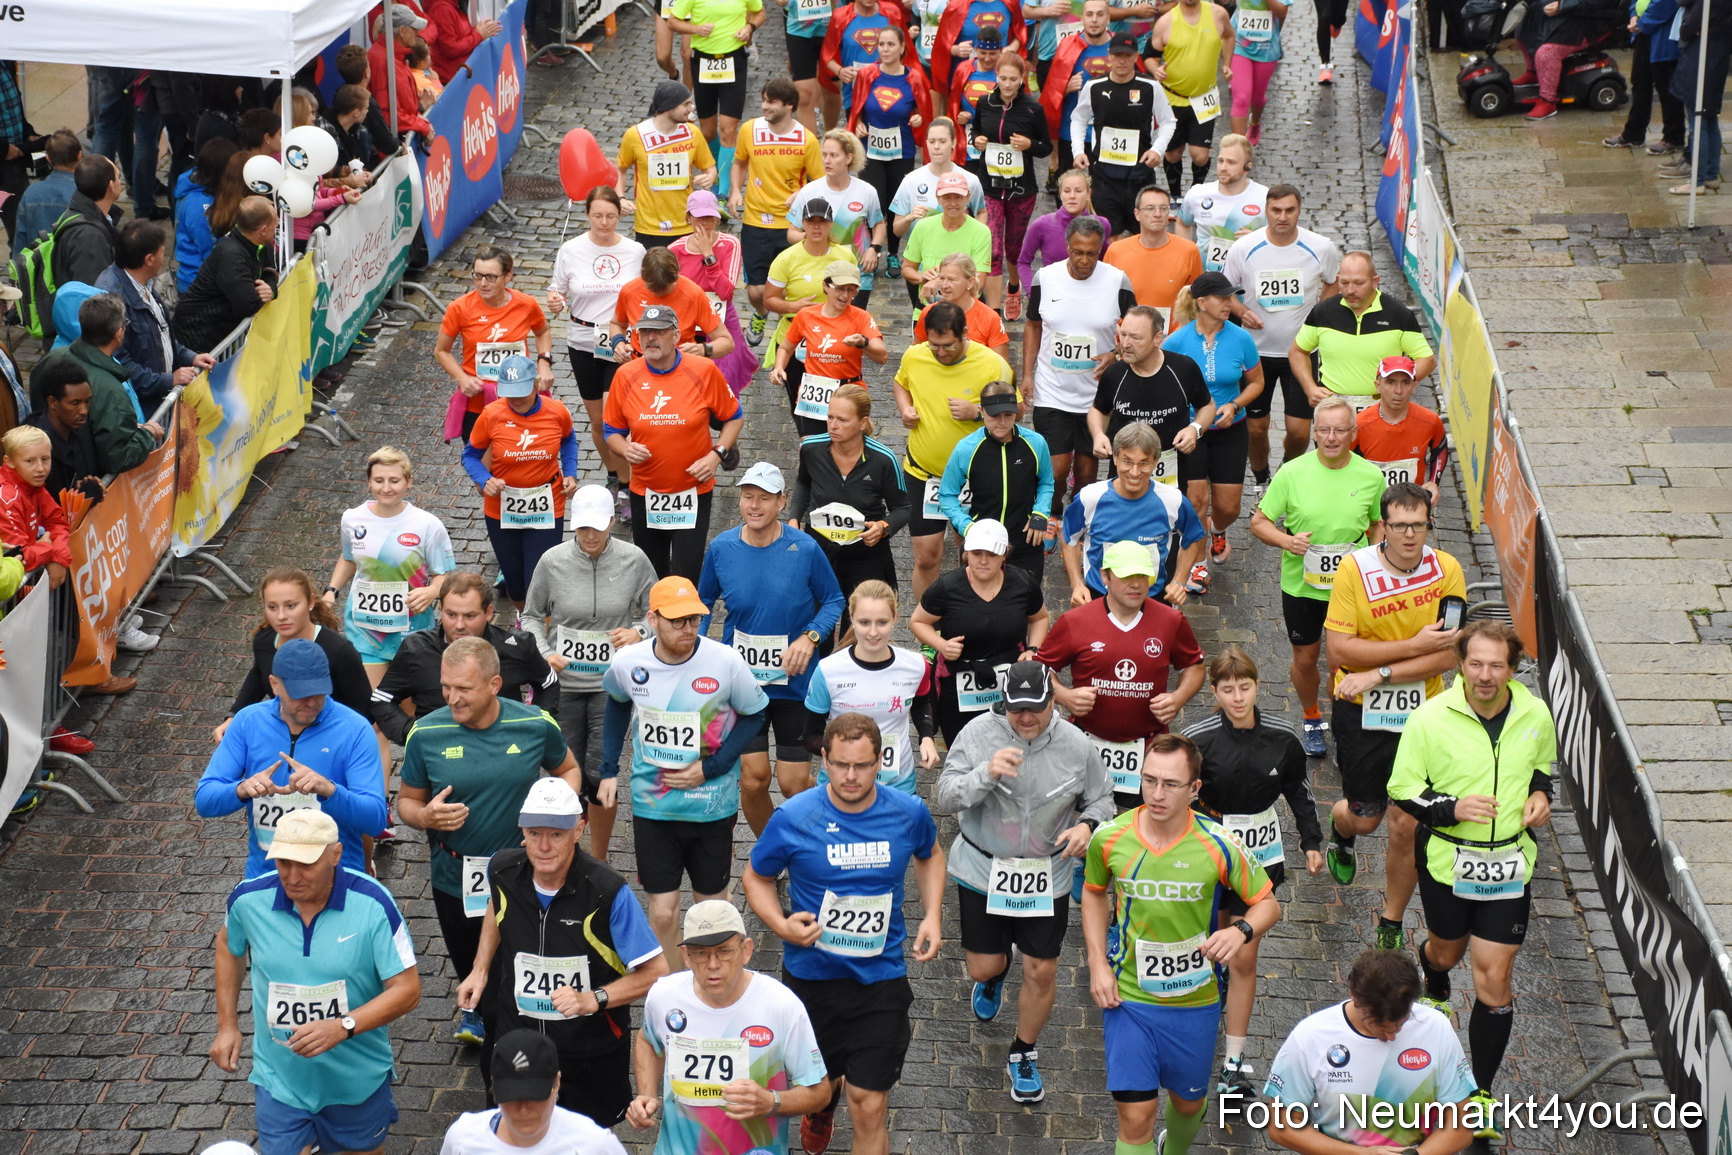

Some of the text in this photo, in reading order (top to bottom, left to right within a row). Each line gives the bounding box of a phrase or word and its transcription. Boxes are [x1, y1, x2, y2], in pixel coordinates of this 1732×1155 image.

[1242, 18, 1269, 30] 2470
[707, 59, 727, 70] 228
[498, 62, 520, 116] Hervis
[1203, 94, 1216, 107] 40
[463, 101, 497, 164] Hervis
[672, 142, 696, 154] BÖGL
[870, 135, 898, 149] 2061
[1111, 137, 1127, 151] 34
[753, 147, 805, 156] MAX BÖGL
[997, 151, 1013, 166] 68
[657, 162, 681, 176] 311
[425, 153, 451, 222] Hervis
[1261, 279, 1300, 296] 2913
[1271, 298, 1290, 306] Armin
[810, 350, 842, 360] funrunners
[1054, 341, 1091, 360] 3071
[801, 384, 834, 404] 2330
[638, 412, 680, 422] funrunners
[1122, 406, 1178, 419] Laufen gegen
[650, 417, 686, 427] neumarkt
[503, 449, 547, 459] funrunners
[515, 453, 553, 462] neumarkt
[506, 495, 550, 514] 2243
[650, 493, 694, 512] 2244
[510, 514, 546, 523] Hannelore
[655, 514, 687, 524] Siegfried
[822, 513, 855, 528] 109
[830, 531, 846, 541] Elke
[358, 591, 404, 613] 2266
[1371, 599, 1409, 619] MAX
[365, 615, 394, 626] Simone
[562, 638, 610, 662] 2838
[737, 644, 783, 668] 3045
[569, 661, 600, 673] Kristina
[695, 681, 717, 690] Hervis
[1091, 677, 1154, 691] NÜRNBERGER
[975, 693, 1000, 704] Nicole
[1369, 689, 1421, 711] 2769
[644, 722, 695, 748] 2612
[653, 749, 684, 762] Thomas
[1096, 747, 1138, 772] 636
[827, 840, 891, 859] HUBER
[1461, 860, 1519, 882] 2337
[995, 870, 1048, 894] 2026
[1116, 878, 1206, 902] BOCK
[1474, 885, 1504, 895] Stefan
[1004, 898, 1036, 909] Norbert
[826, 908, 885, 934] 2223
[830, 934, 875, 949] Johannes
[1145, 949, 1204, 977] 2859
[523, 969, 584, 996] 2464
[1160, 978, 1193, 990] Tobias
[276, 997, 342, 1026] 2654
[745, 1030, 771, 1043] Hervis
[1402, 1051, 1429, 1066] Hervis
[684, 1054, 734, 1082] 279
[1327, 1071, 1353, 1079] PARTL
[694, 1086, 723, 1097] Heinz
